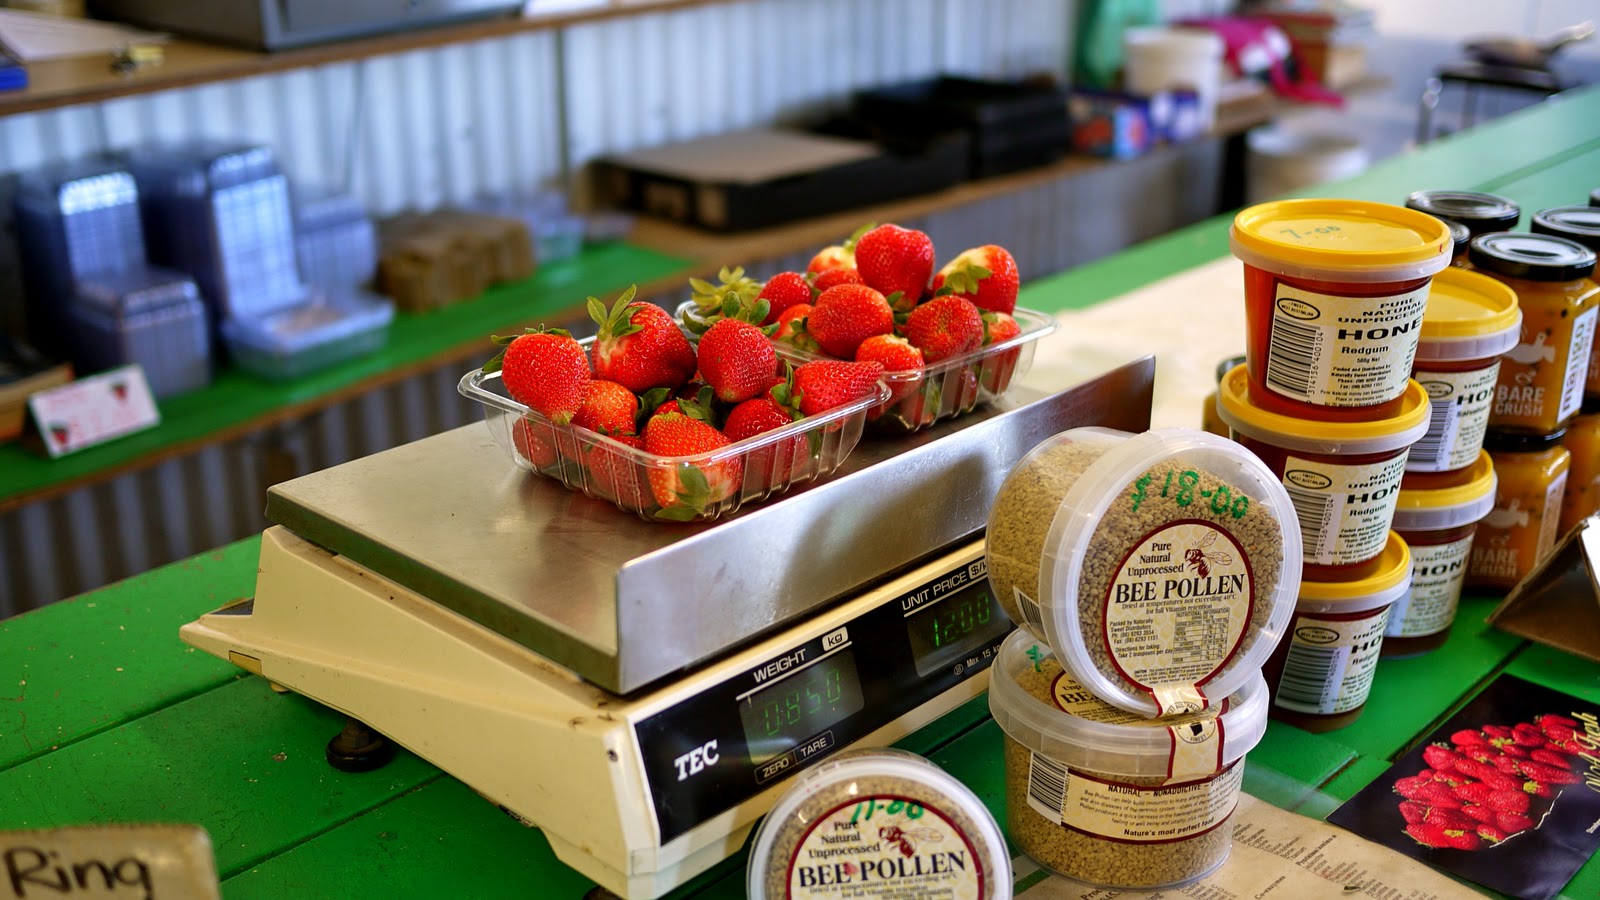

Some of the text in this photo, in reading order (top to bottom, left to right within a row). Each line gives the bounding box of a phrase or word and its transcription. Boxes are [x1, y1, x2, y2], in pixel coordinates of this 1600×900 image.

[1363, 301, 1422, 316] NATURAL
[1380, 298, 1415, 308] PURE
[1338, 313, 1424, 340] HONE
[1341, 346, 1388, 354] Redgum
[1496, 384, 1545, 403] BARE
[1495, 401, 1543, 416] CRUSH
[1152, 542, 1172, 551] Pure
[1139, 553, 1171, 564] Natural
[1128, 563, 1184, 577] Unprocessed
[902, 589, 929, 610] UNIT
[933, 571, 967, 596] PRICE
[1115, 574, 1245, 604] BEE POLLEN
[1146, 599, 1183, 607] temperatures
[1195, 596, 1222, 604] exceeding
[753, 633, 843, 683] WEIGHT kg
[966, 656, 980, 667] Max
[982, 651, 991, 659] 15
[1190, 734, 1206, 742] FINEST
[674, 739, 719, 781] TEC
[762, 737, 827, 779] ZERO TARE
[1108, 785, 1141, 797] NATURAL
[1154, 784, 1201, 797] NONADDICTIVE
[834, 821, 859, 831] Pure
[1178, 824, 1200, 834] perfect
[1202, 817, 1214, 827] food
[822, 833, 861, 845] Natural
[809, 842, 881, 859] Unprocessed
[3, 846, 155, 900] Ring
[798, 850, 965, 888] BEE POLLEN
